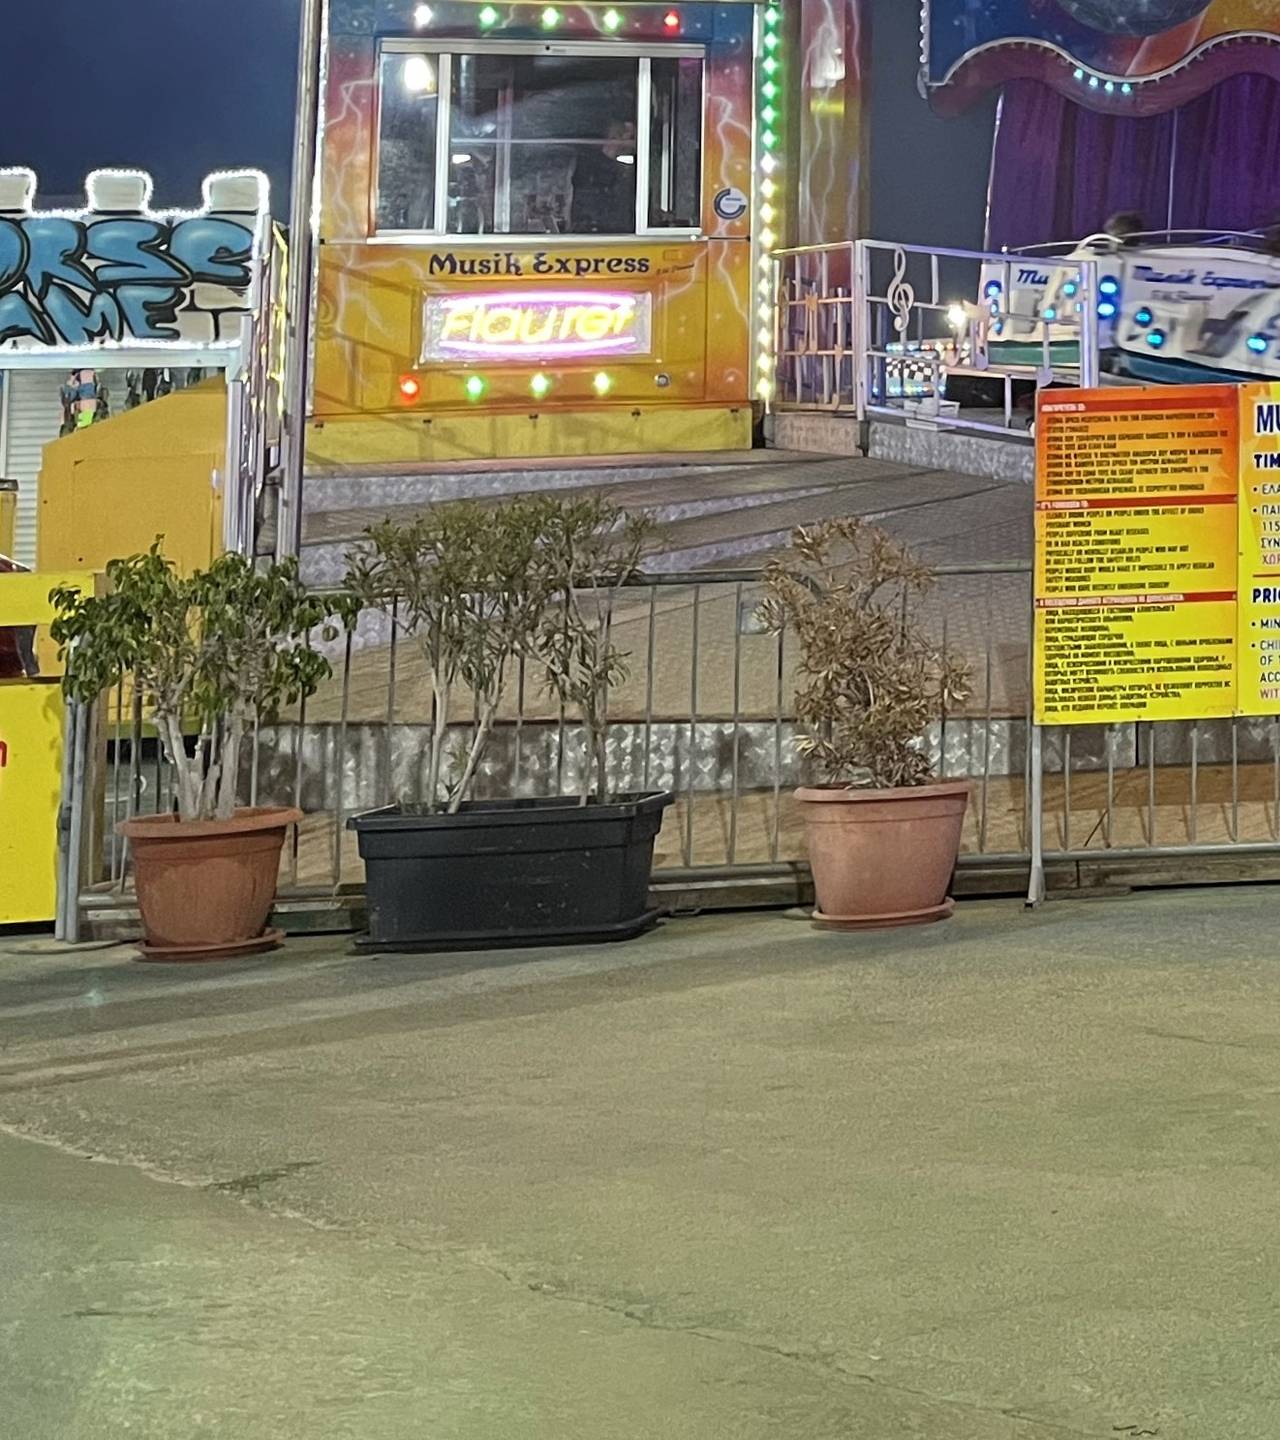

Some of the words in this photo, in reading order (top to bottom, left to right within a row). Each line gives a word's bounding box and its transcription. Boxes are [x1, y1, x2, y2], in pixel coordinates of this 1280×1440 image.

[428, 252, 523, 276] Musik
[532, 252, 650, 277] Express
[1262, 521, 1280, 532] 115
[1260, 655, 1273, 665] OF
